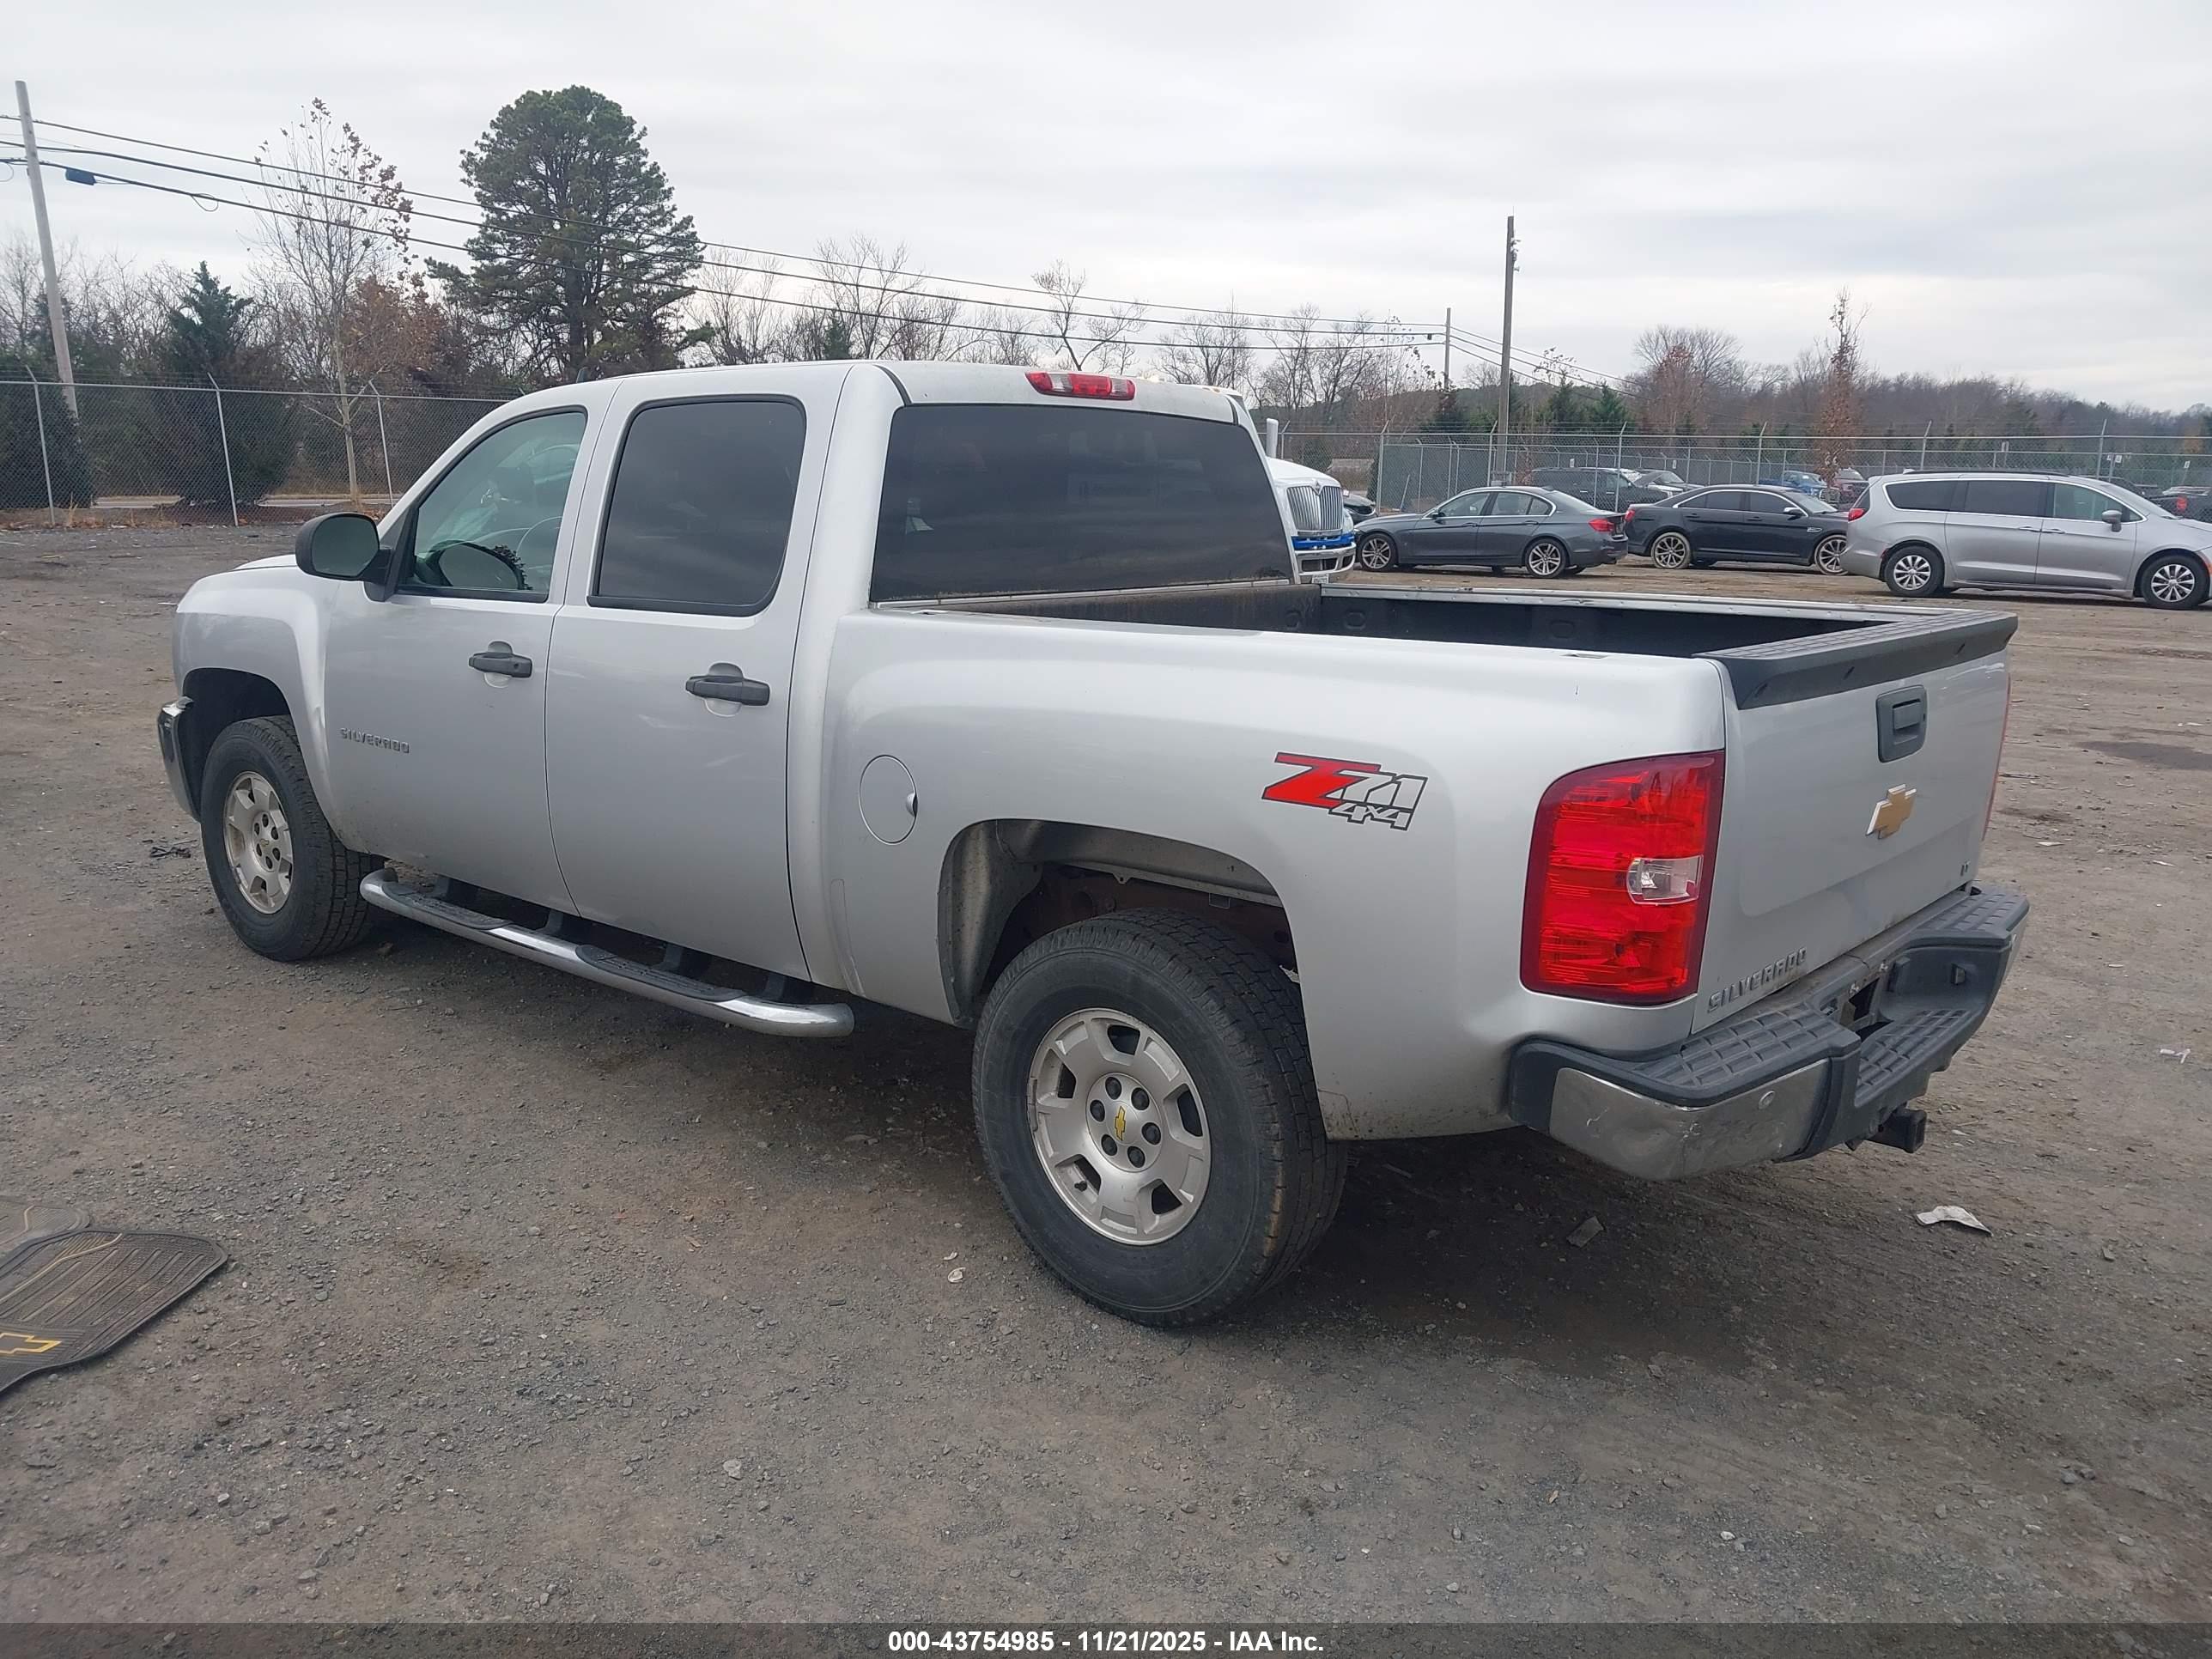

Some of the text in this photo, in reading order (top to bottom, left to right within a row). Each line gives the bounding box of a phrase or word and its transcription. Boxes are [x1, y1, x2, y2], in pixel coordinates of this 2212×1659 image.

[340, 727, 410, 754] SILVERADO
[1261, 751, 1429, 814] Z71
[1707, 946, 1808, 1013] SILVERADO
